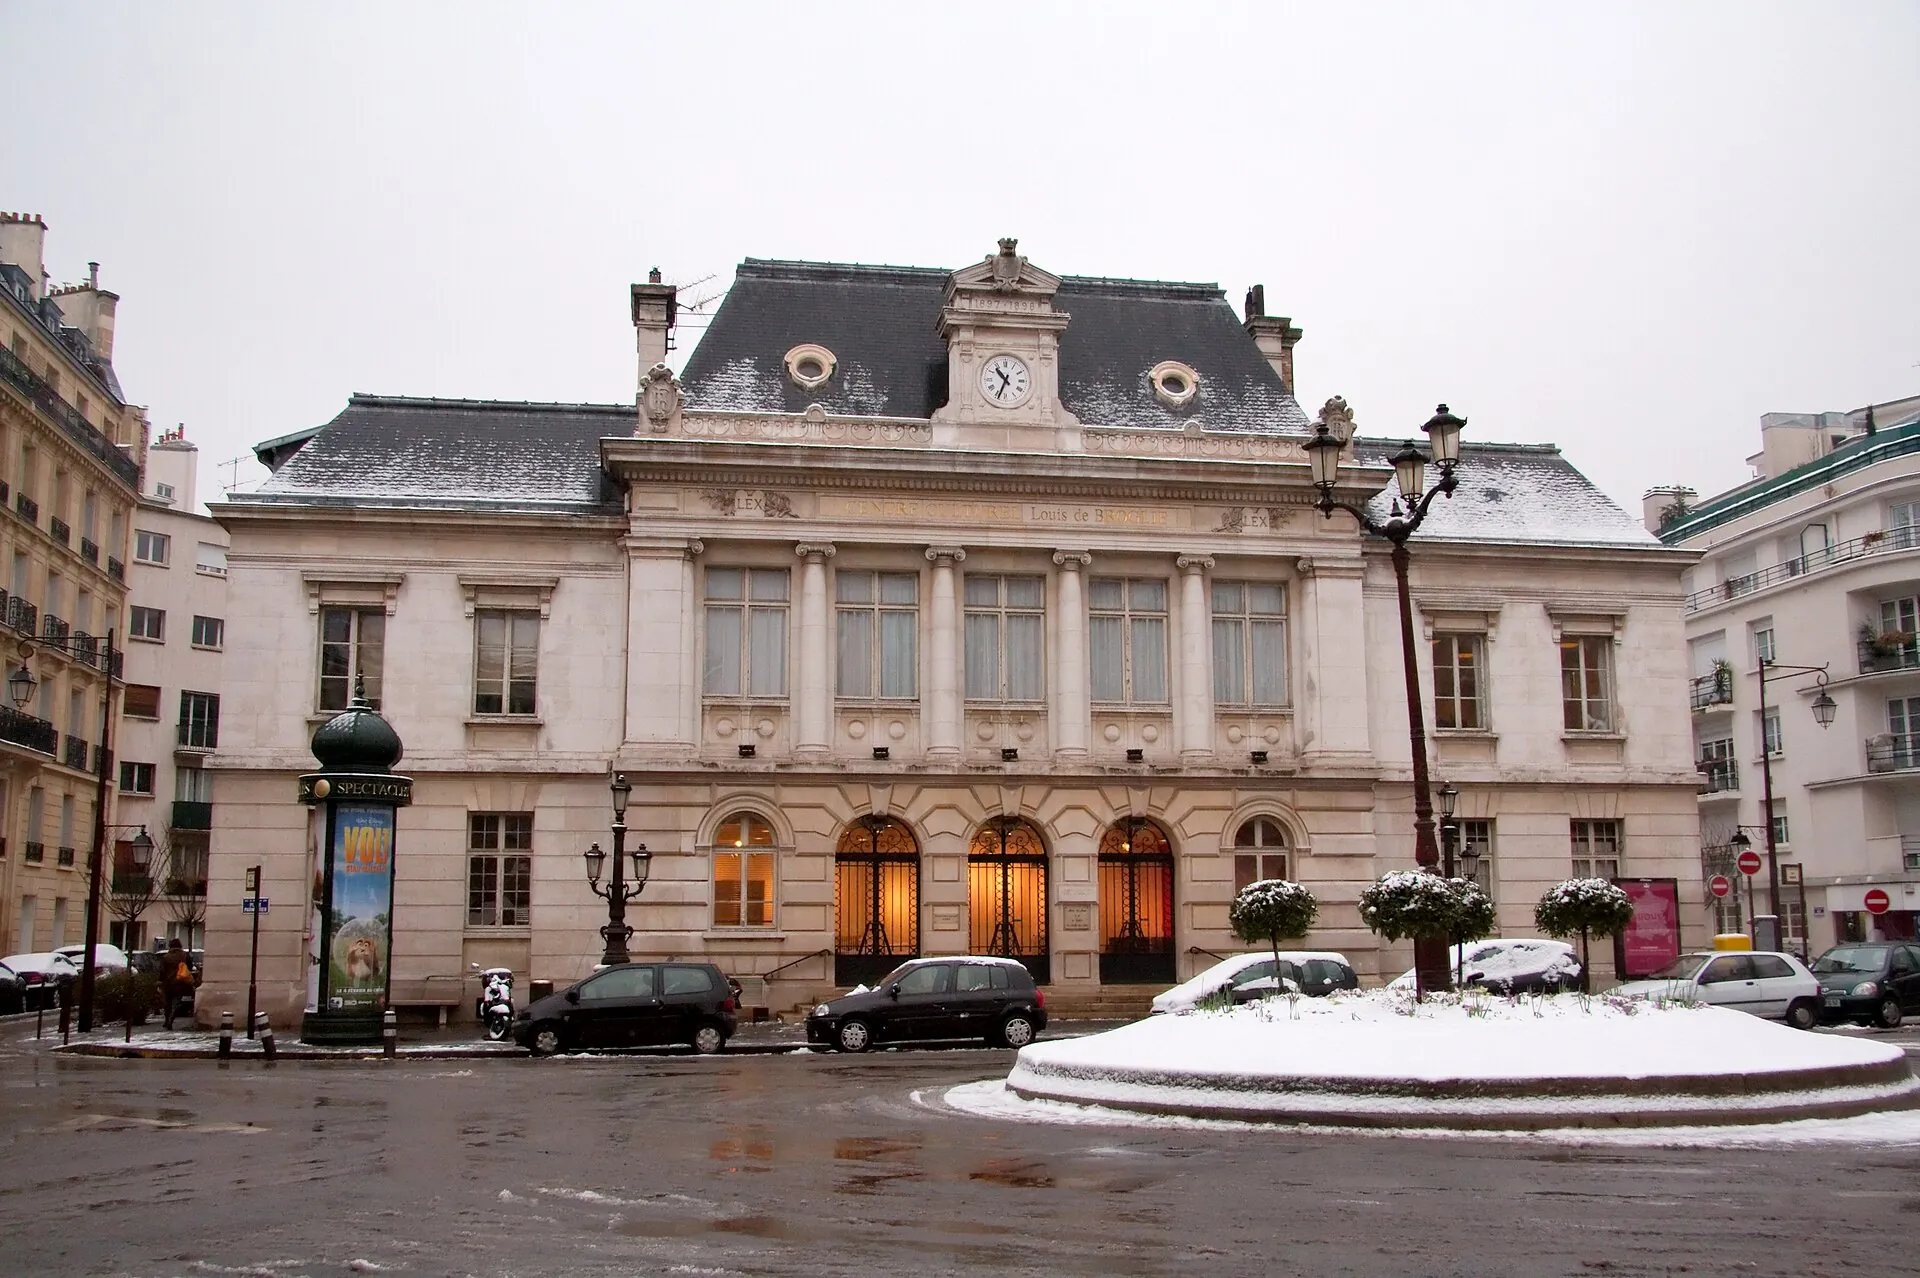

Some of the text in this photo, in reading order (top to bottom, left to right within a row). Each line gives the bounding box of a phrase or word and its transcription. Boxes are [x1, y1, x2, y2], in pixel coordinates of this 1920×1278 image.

[974, 299, 1000, 309] 1897
[737, 498, 763, 510] LEX
[1031, 506, 1167, 525] Louis de BROGLIE
[1242, 515, 1268, 528] LEX
